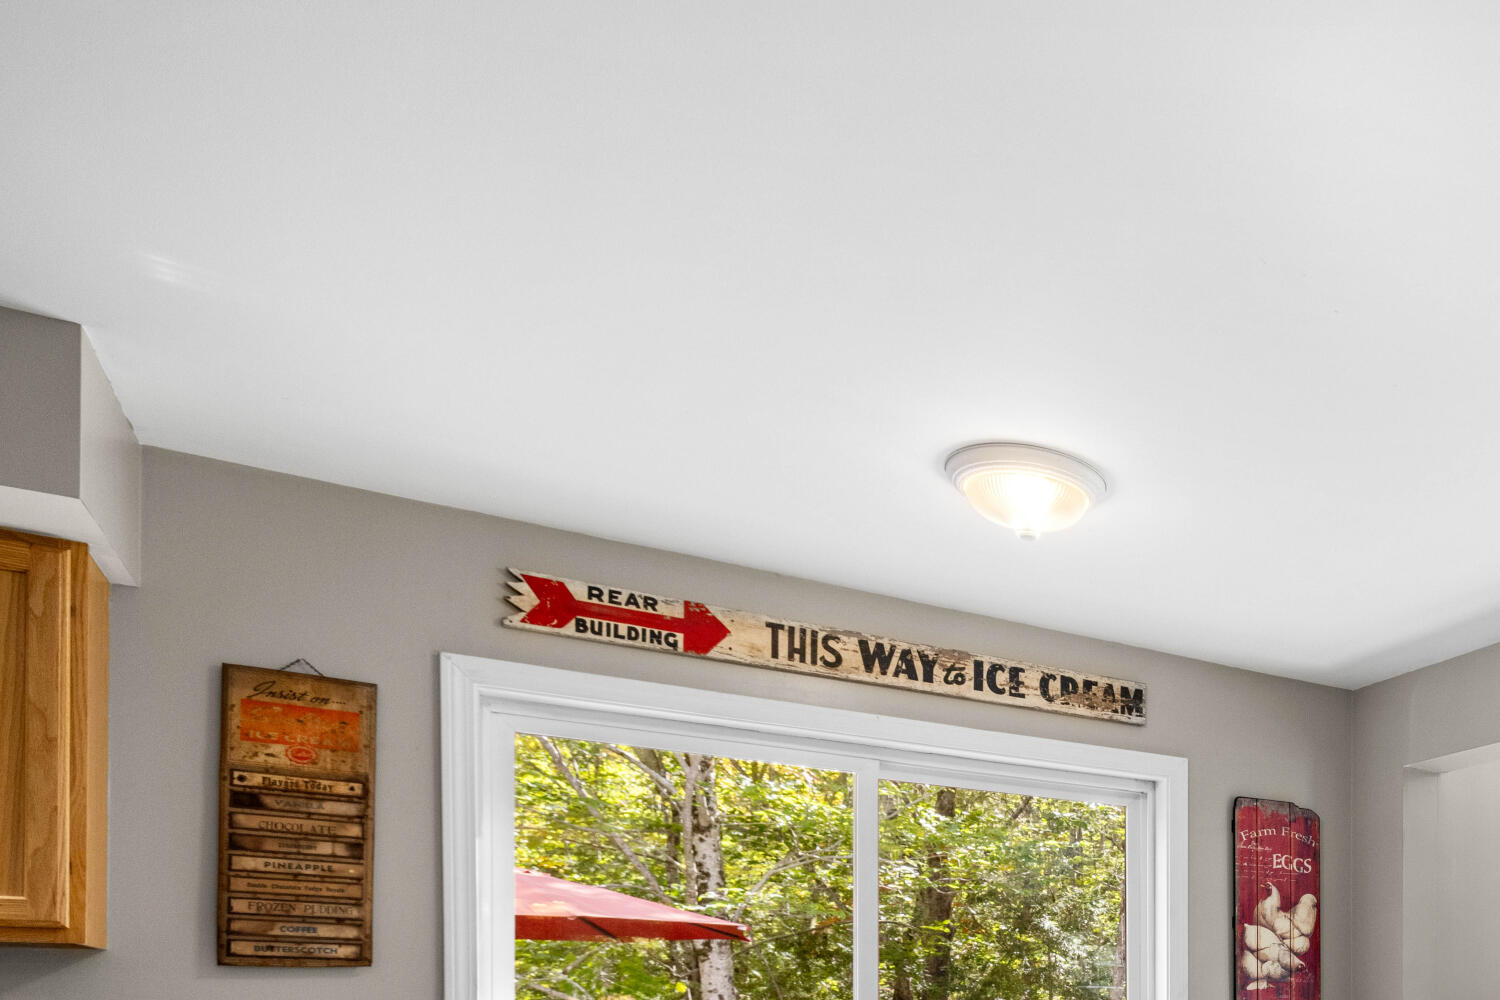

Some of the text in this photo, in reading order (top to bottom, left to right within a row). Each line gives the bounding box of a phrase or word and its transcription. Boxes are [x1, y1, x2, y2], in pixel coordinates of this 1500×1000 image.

[587, 585, 658, 612] REAR
[575, 617, 678, 651] BUILDING
[765, 621, 843, 668] THIS
[858, 639, 939, 684] WAY
[943, 663, 966, 686] to
[973, 659, 1026, 698] ICE
[246, 680, 309, 701] Insist
[303, 779, 333, 792] Today
[258, 821, 336, 835] CHOCOLATE
[1240, 828, 1276, 841] Farm
[1281, 826, 1316, 847] Fresh
[264, 861, 334, 873] PINEAPPLE
[1272, 853, 1312, 874] EGGS
[247, 901, 296, 913] FROZEN
[279, 925, 318, 934] COFFEE
[253, 944, 338, 954] BUTTERSCOTCH
